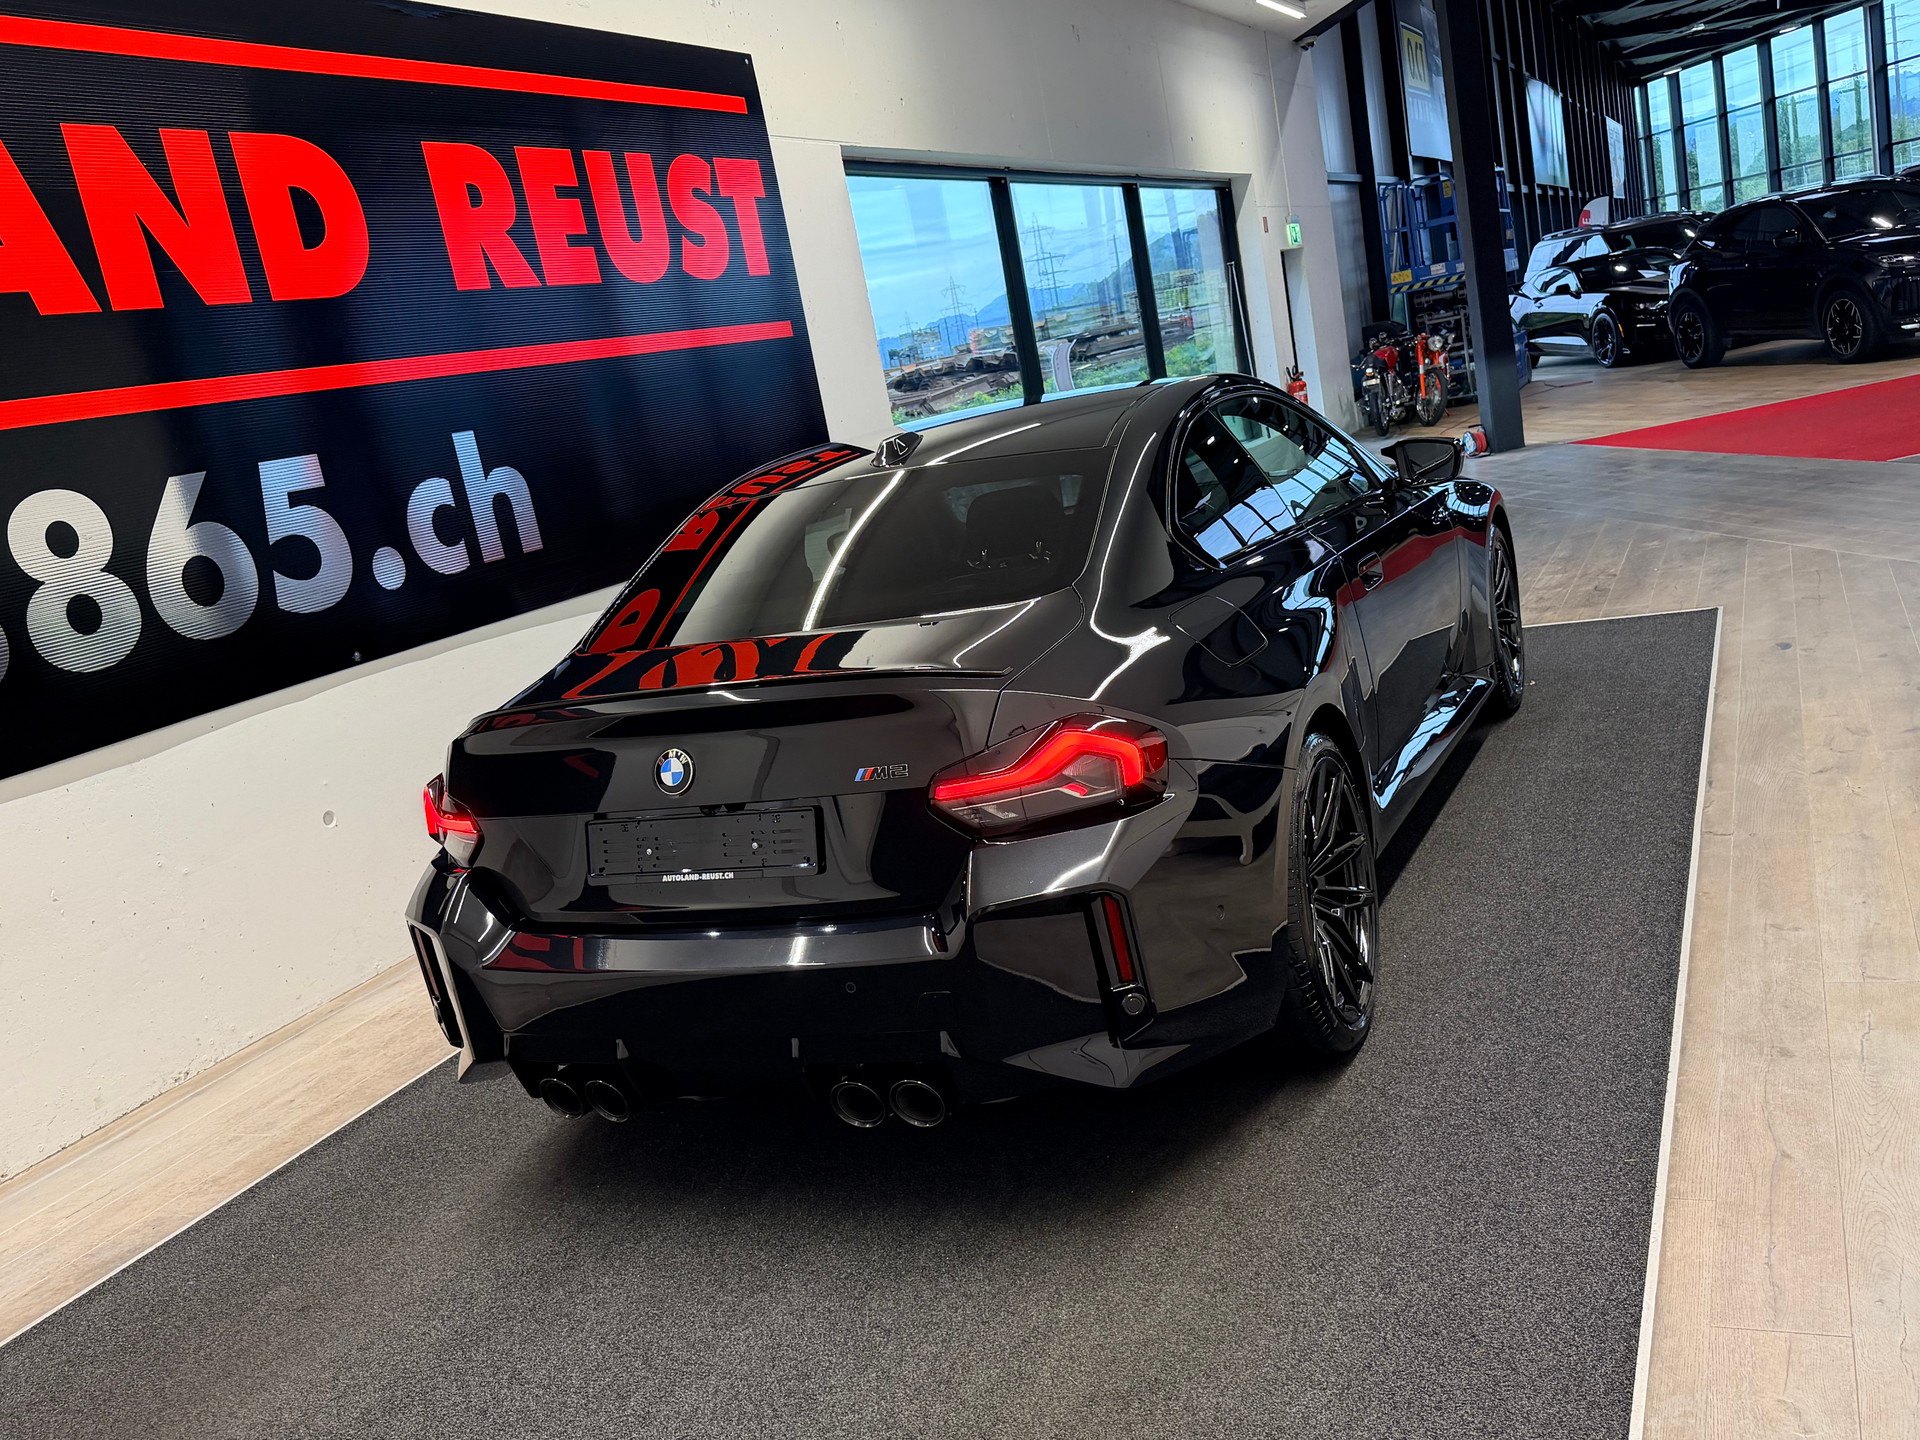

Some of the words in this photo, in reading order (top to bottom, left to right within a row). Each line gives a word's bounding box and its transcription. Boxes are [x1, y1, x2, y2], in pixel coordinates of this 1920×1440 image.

[421, 141, 771, 291] REUST
[0, 430, 543, 683] 865.ch
[657, 749, 689, 766] BMW
[864, 763, 909, 781] M2
[662, 871, 734, 882] AUTOLAND-REUST.CH
